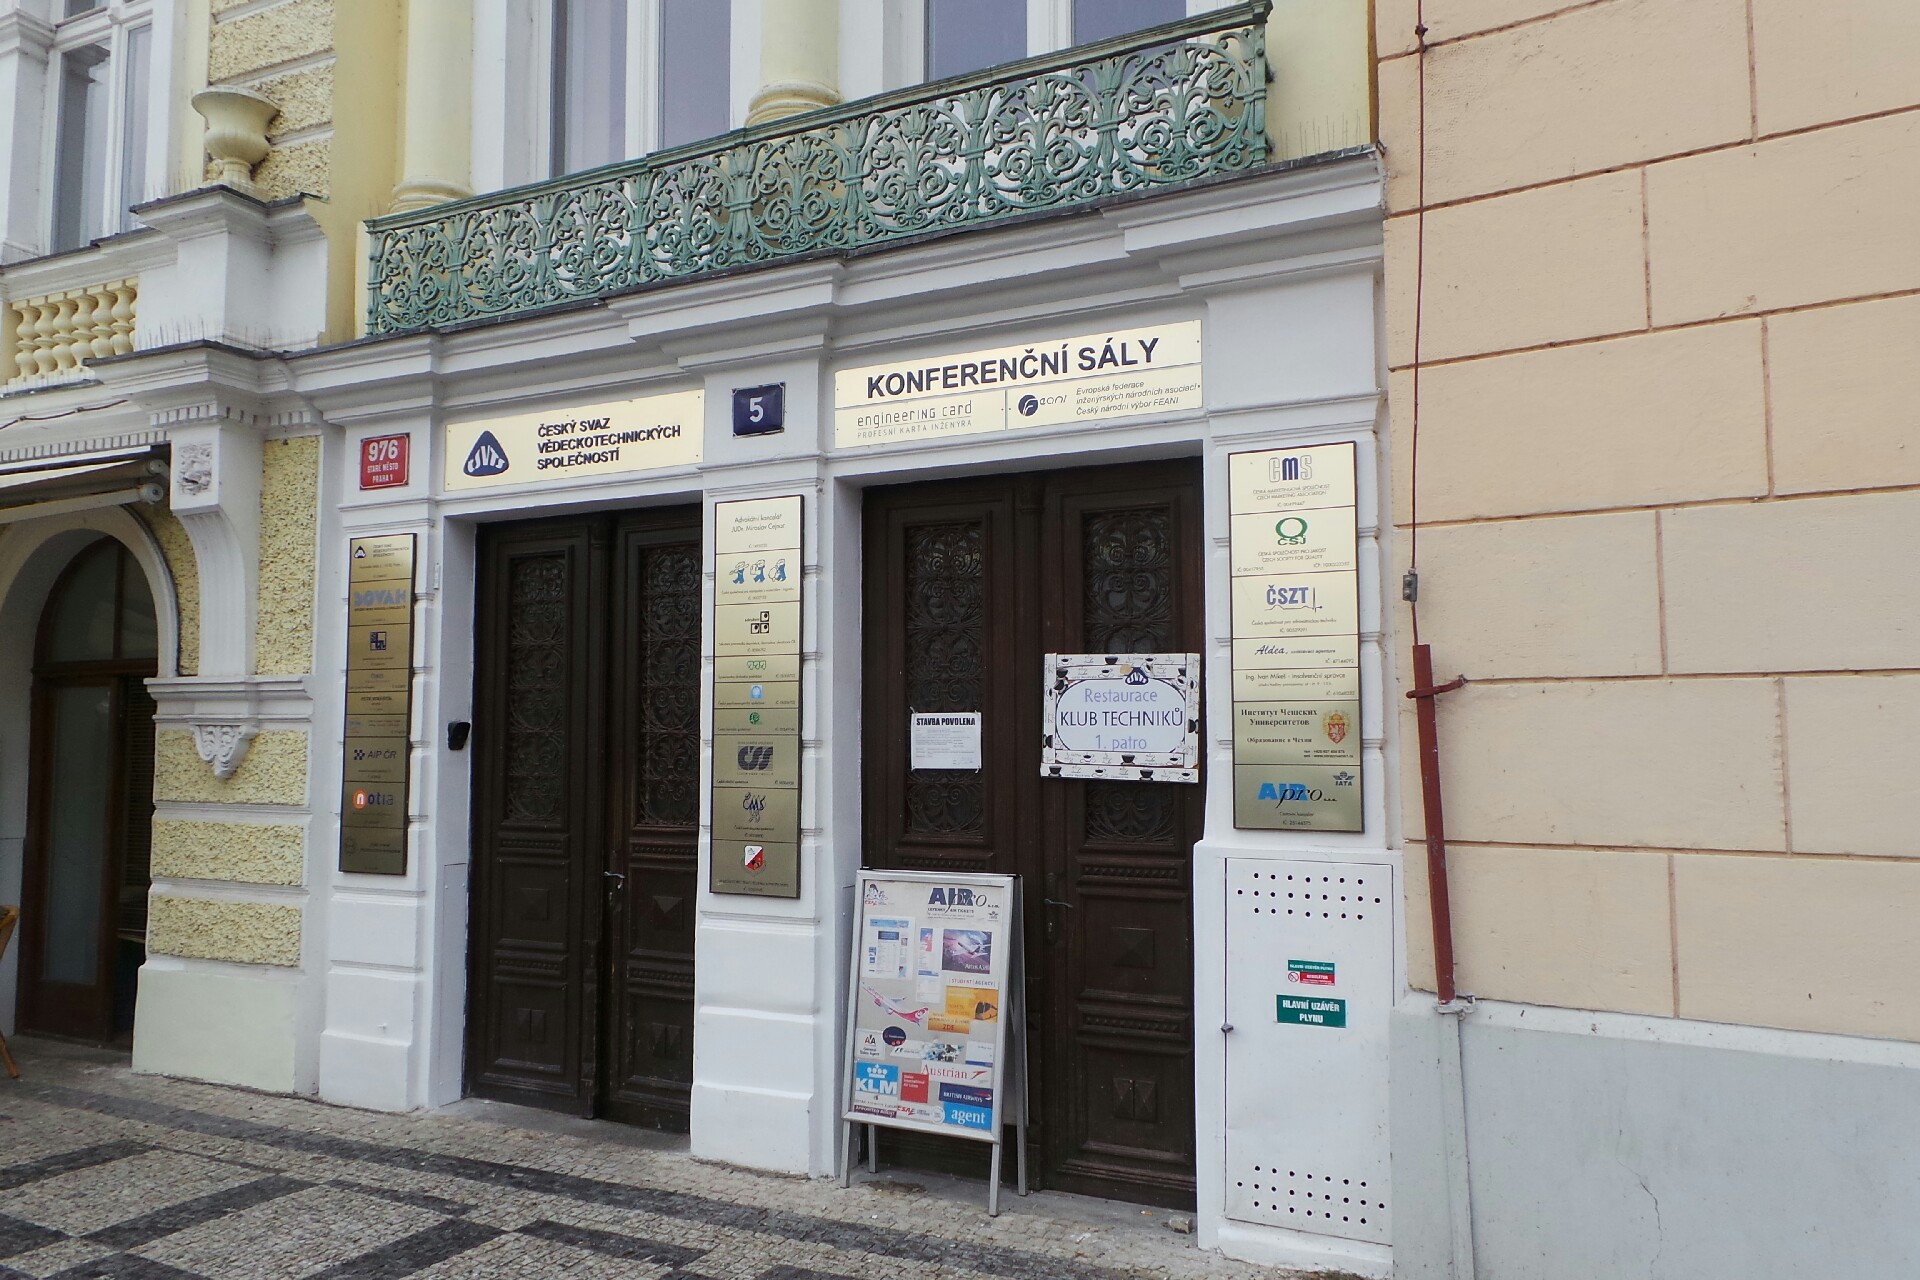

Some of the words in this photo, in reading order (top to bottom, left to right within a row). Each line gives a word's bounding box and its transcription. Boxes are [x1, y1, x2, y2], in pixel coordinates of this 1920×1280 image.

[867, 343, 1069, 399] KONFERENČNÍ
[1077, 336, 1160, 371] SÁLY
[749, 396, 764, 423] 5
[942, 399, 972, 417] card
[537, 419, 576, 438] ČESKÝ
[579, 417, 611, 432] SVAZ
[899, 425, 928, 436] KARTA
[537, 424, 681, 454] VĚDECKOTECHNICKÝCH
[368, 439, 399, 462] 976
[537, 447, 620, 470] SPOLEČNOSTÍ
[1266, 584, 1309, 605] ČSZT
[1084, 688, 1158, 703] Restaurace
[916, 717, 940, 726] STAVBA
[941, 717, 976, 726] POVOLENA
[1060, 710, 1098, 726] KLUB
[1102, 707, 1183, 726] TECHNIKŮ
[1095, 734, 1107, 750] 1.
[1111, 736, 1147, 752] patro
[1282, 999, 1309, 1010] HLAVNÍ
[1311, 1000, 1340, 1012] UZÁVĚR
[1299, 1013, 1324, 1024] PLYNU
[921, 1063, 968, 1080] Austrian
[855, 1077, 898, 1095] KLM
[943, 1091, 962, 1100] BRITISH
[962, 1093, 983, 1103] AIRWAYS
[951, 1108, 986, 1125] agent
